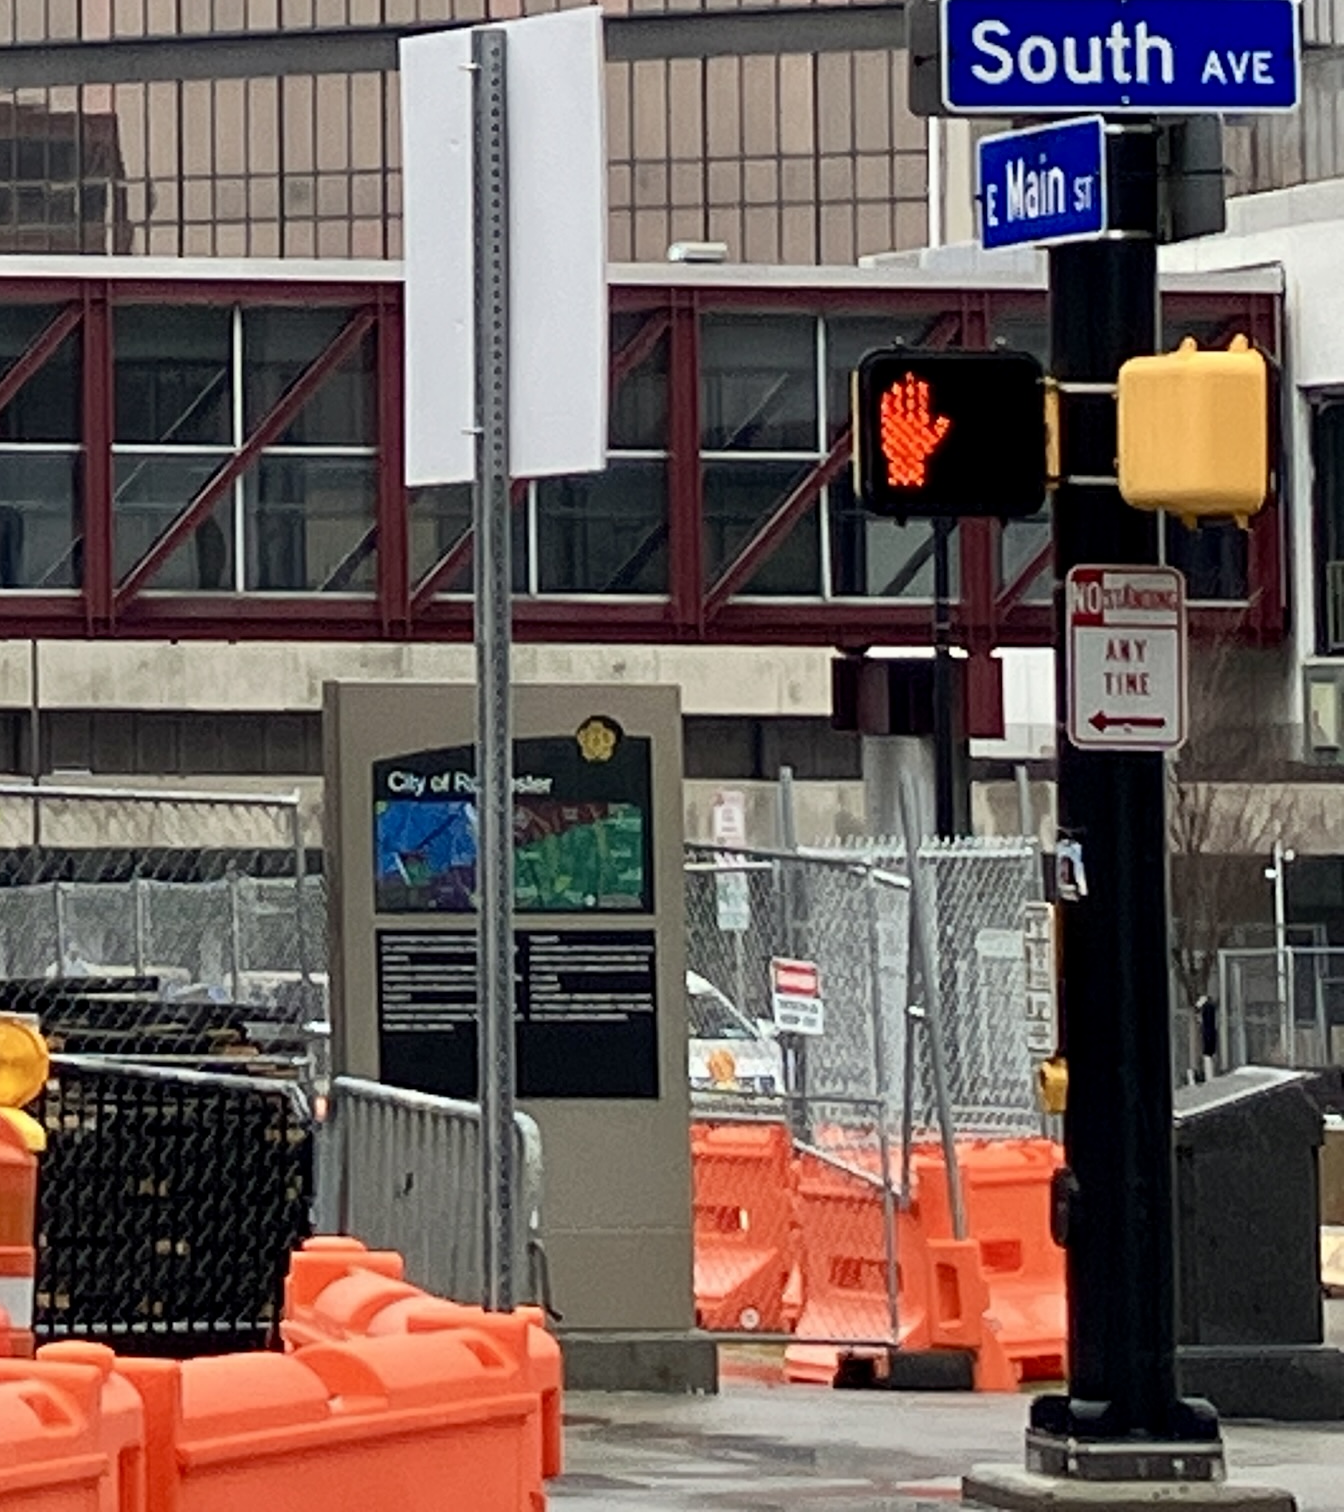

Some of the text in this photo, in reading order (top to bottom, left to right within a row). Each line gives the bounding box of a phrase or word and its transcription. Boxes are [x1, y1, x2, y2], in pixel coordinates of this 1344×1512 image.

[971, 19, 1275, 85] South AVE
[987, 158, 1094, 227] E Main ST
[1072, 580, 1101, 614] NO
[1106, 639, 1147, 663] ANY
[1104, 672, 1150, 696] TIME
[387, 771, 426, 797] City
[430, 771, 450, 792] of
